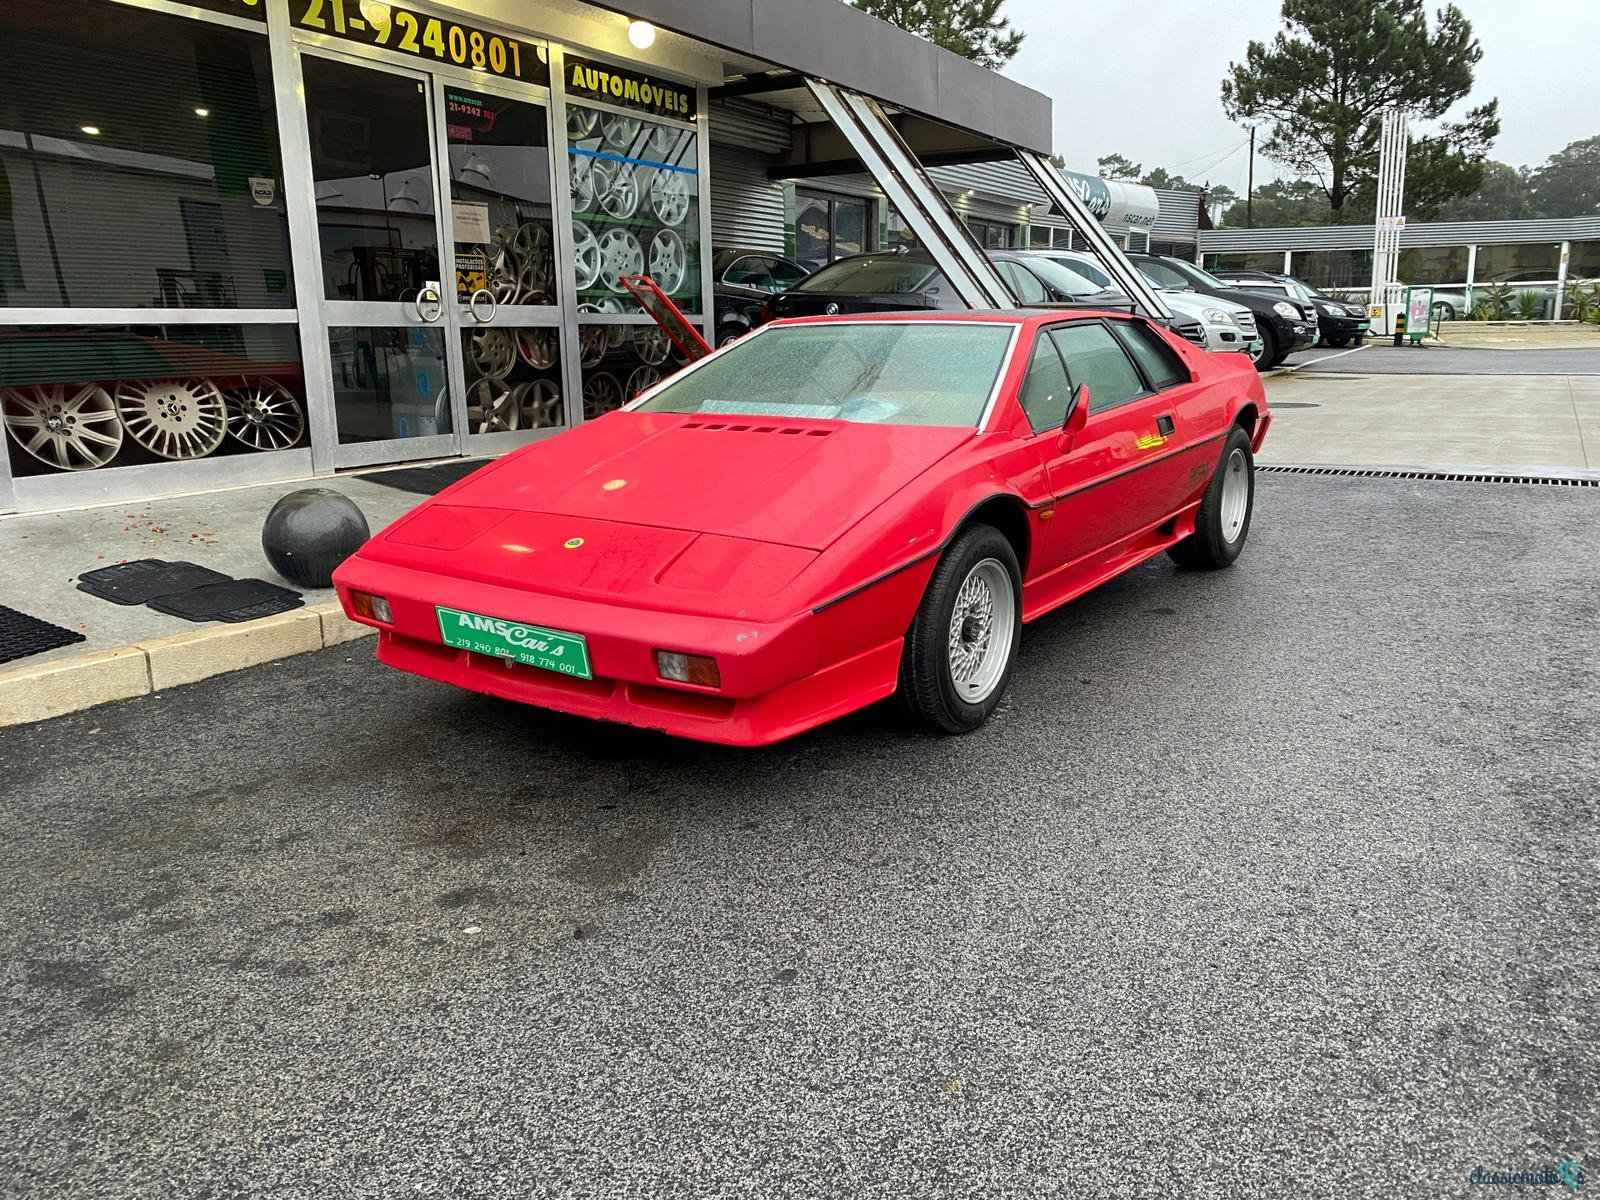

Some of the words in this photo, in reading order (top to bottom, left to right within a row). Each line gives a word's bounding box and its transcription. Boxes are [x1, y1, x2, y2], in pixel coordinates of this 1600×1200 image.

[301, 0, 520, 77] 21-9240801
[572, 65, 688, 114] AUTOMÓVEIS
[456, 637, 471, 648] 219
[474, 643, 491, 653] 240
[520, 653, 535, 664] 918
[539, 657, 556, 669] 774
[559, 663, 575, 674] 001
